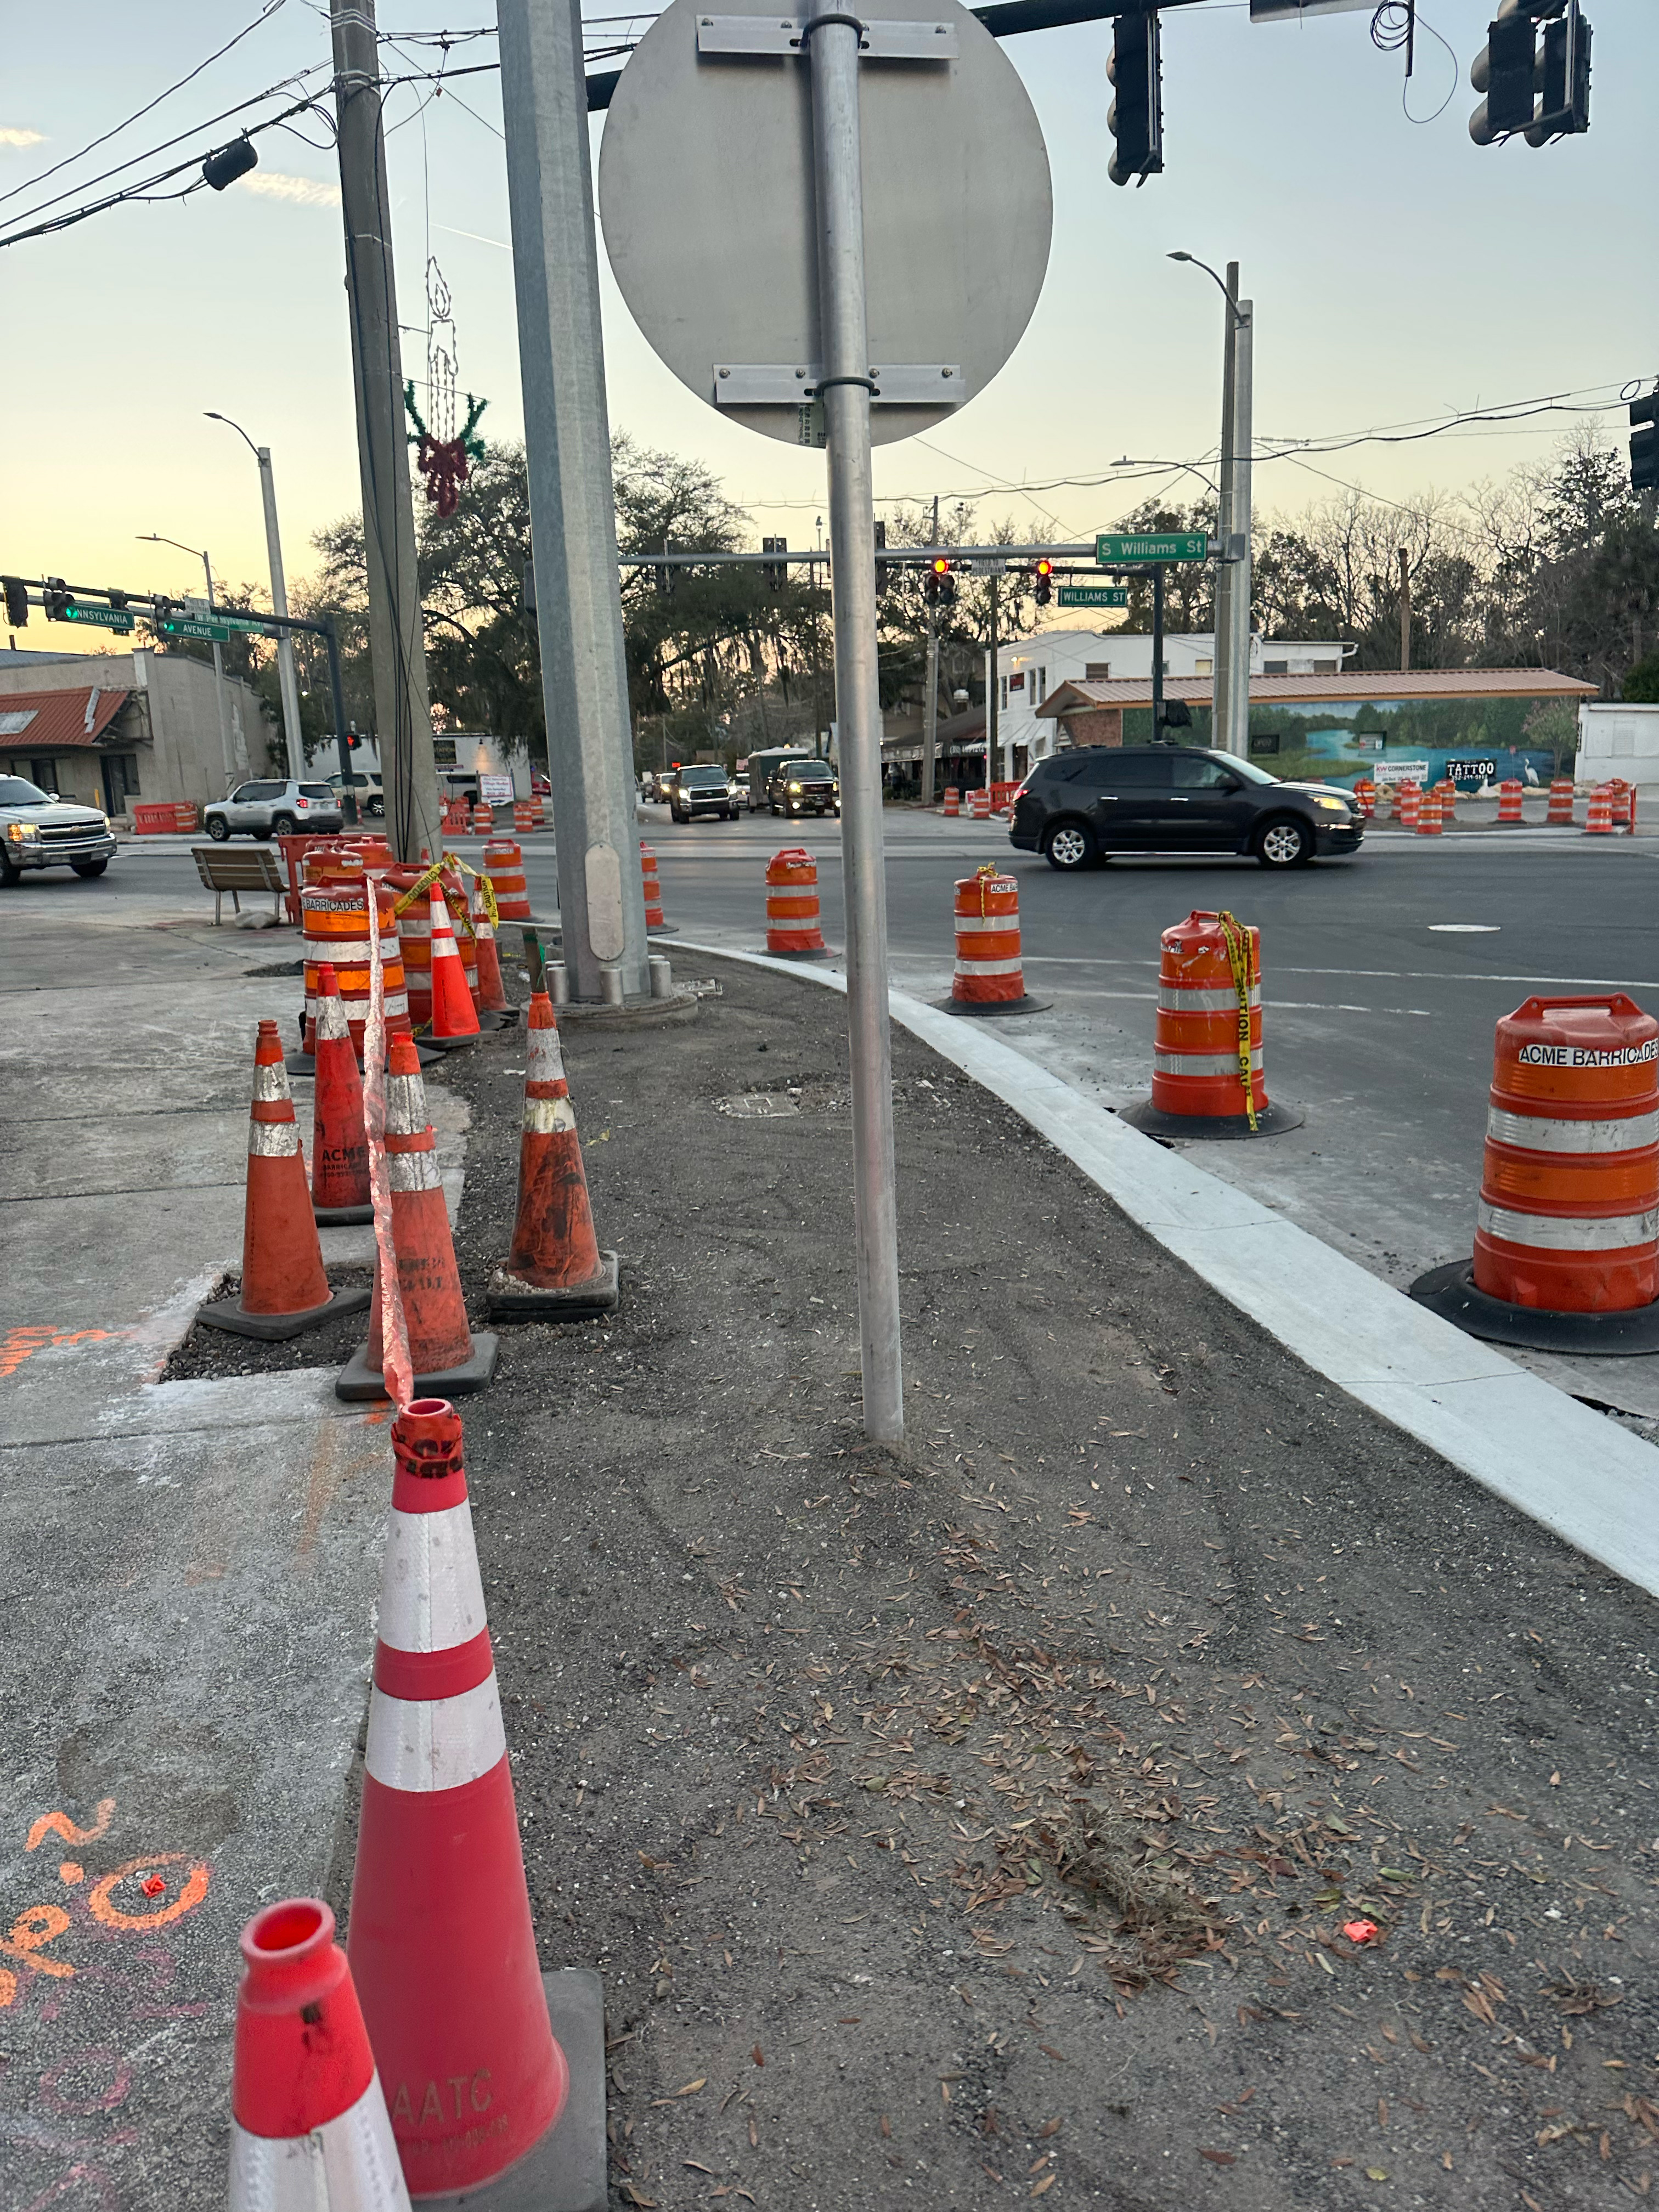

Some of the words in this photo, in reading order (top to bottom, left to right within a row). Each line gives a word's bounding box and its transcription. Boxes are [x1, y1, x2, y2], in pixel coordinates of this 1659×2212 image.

[1102, 543, 1111, 556] S
[1121, 541, 1177, 555] Williams
[1186, 539, 1202, 553] St
[1063, 591, 1108, 602] WILLIAMS
[1112, 592, 1125, 602] ST
[77, 608, 128, 624] NNSYLVANIA
[183, 624, 212, 636] AVENUE
[1376, 764, 1387, 772] kw
[1447, 762, 1494, 776] TATTOO
[991, 883, 1009, 893] ACME
[306, 898, 364, 911] BARRICADES
[1520, 1046, 1568, 1065] ACME
[1573, 1037, 1659, 1066] BARRICADES
[322, 1146, 366, 1161] ACME
[391, 2068, 493, 2127] AATC
